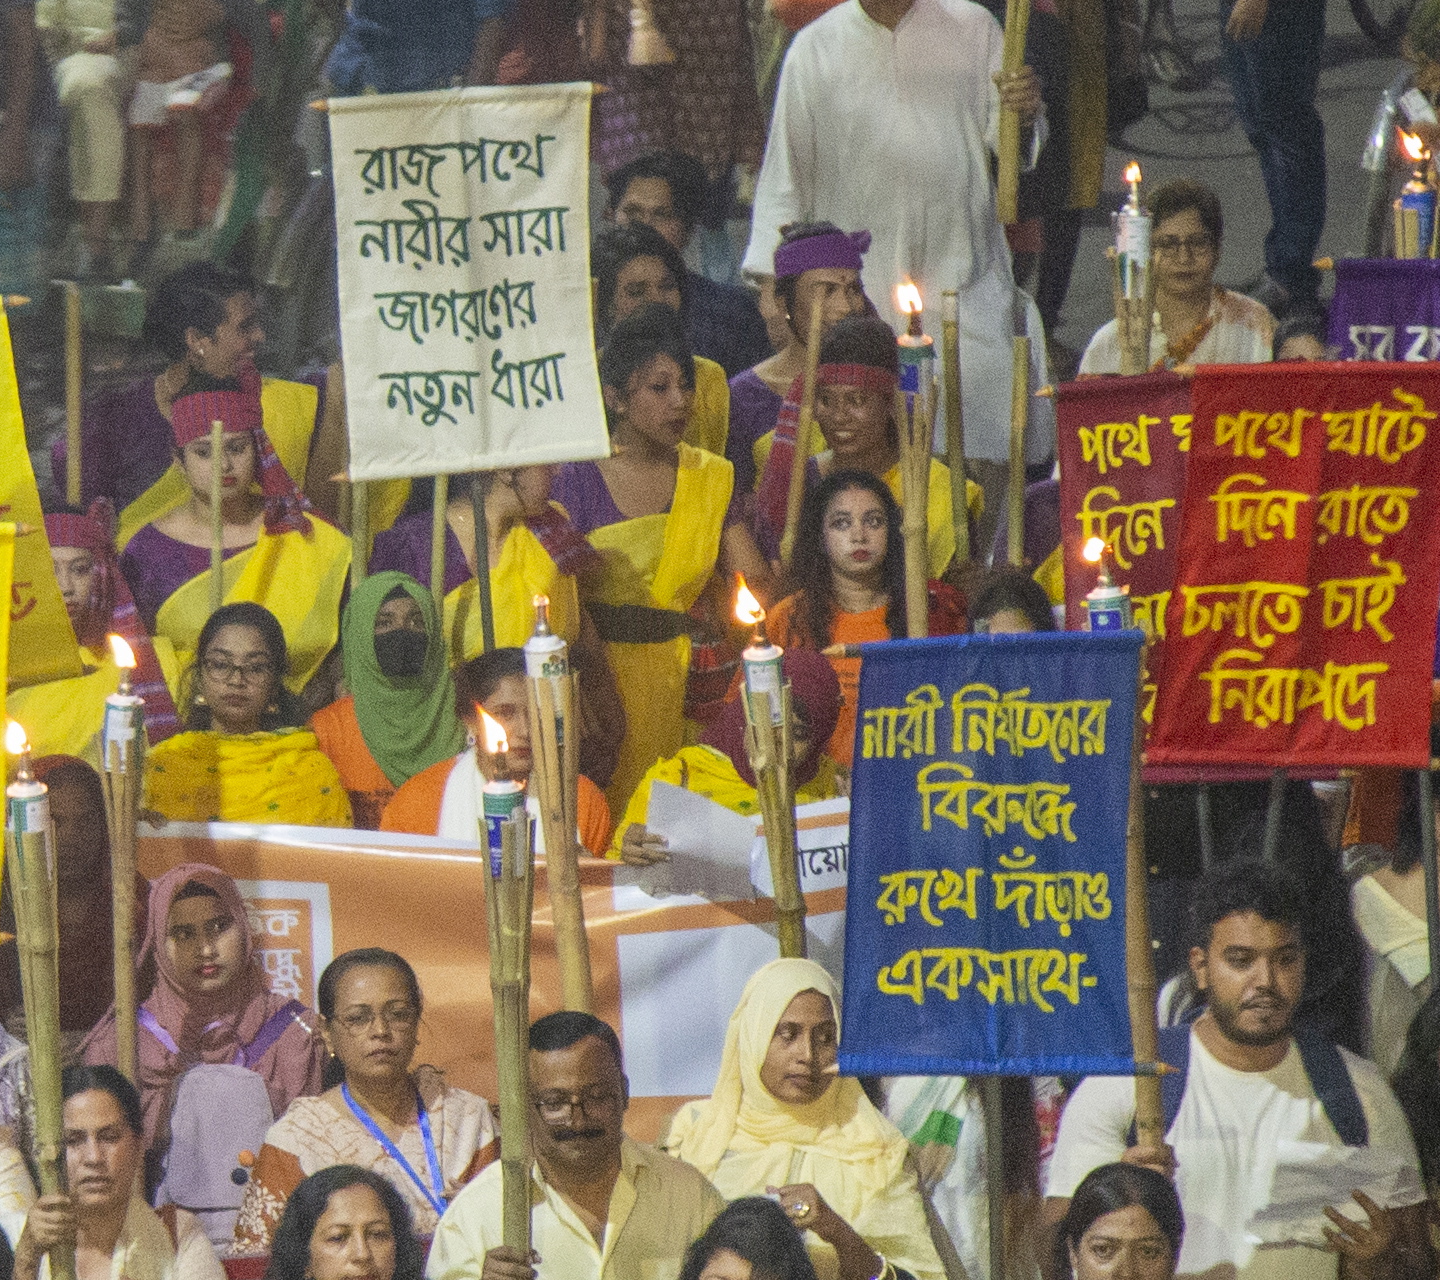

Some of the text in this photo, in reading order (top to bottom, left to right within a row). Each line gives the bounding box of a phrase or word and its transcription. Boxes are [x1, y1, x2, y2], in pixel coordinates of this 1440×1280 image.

[354, 199, 569, 269] নারীর সারা
[374, 278, 536, 344] জাগরণের
[380, 349, 565, 426] নতুন ধারা
[1215, 408, 1316, 459] পথে
[1322, 387, 1437, 464] ঘাটে
[1079, 414, 1160, 474] পথে
[1209, 473, 1310, 547] দিনে
[1317, 482, 1418, 545] রাতে
[1181, 581, 1310, 647] চলতে
[1319, 553, 1406, 642] চাই
[862, 684, 944, 760] নারী
[1200, 649, 1389, 731] নিরাপদে
[917, 761, 1077, 842] বিরুদ্ধে
[877, 847, 1112, 937] রুখে দাঁড়াও
